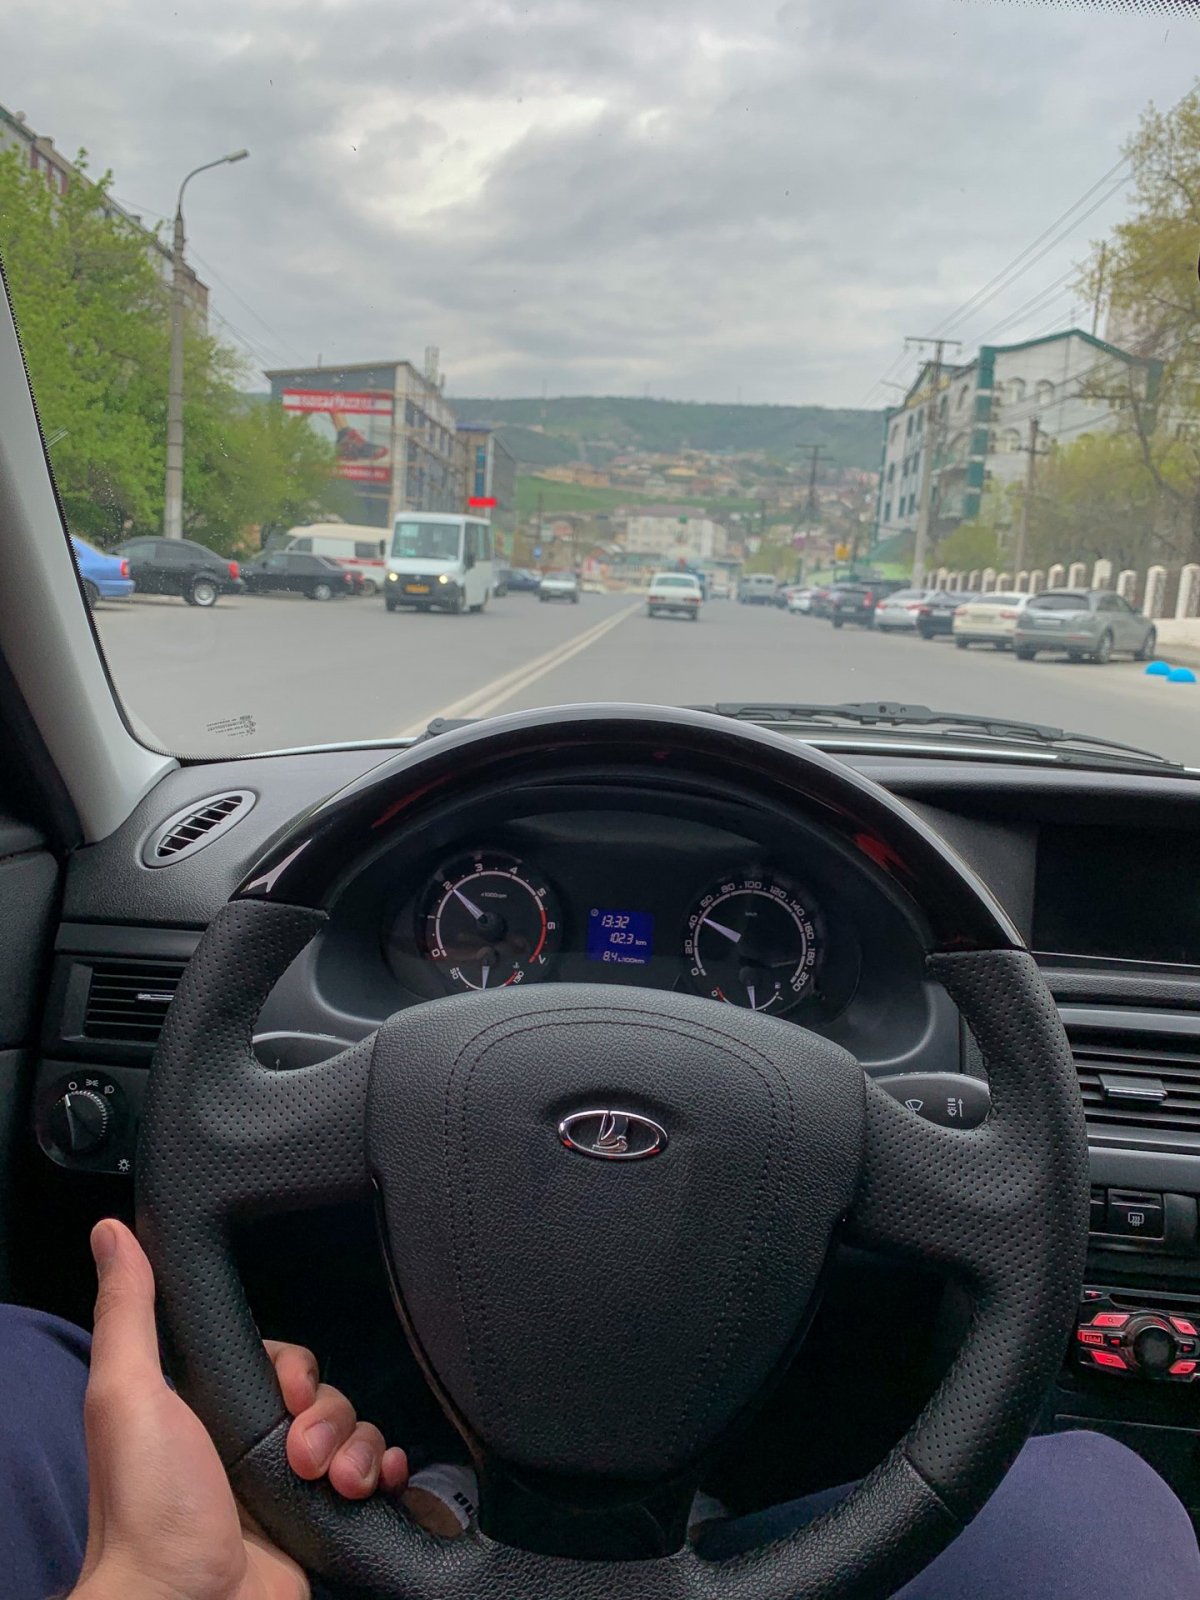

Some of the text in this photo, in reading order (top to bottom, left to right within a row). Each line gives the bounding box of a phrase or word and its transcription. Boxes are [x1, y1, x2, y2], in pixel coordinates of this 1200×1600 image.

[475, 863, 484, 872] 3
[509, 866, 518, 875] 4
[442, 880, 454, 891] 2
[721, 882, 736, 893] 80
[744, 881, 762, 889] 100
[536, 887, 547, 898] 5
[769, 885, 788, 900] 120
[700, 894, 714, 908] 60
[789, 900, 806, 917] 140
[547, 921, 556, 930] 6
[601, 914, 630, 929] 13:32
[688, 914, 699, 930] 40
[803, 921, 815, 941] 160
[610, 932, 634, 945] 102.3
[431, 948, 441, 958] 0
[684, 939, 693, 954] 20
[538, 954, 547, 965] 7
[805, 947, 816, 967] 180
[449, 966, 459, 980] 50
[513, 970, 525, 984] 130
[691, 967, 700, 976] 0
[792, 971, 810, 992] 200
